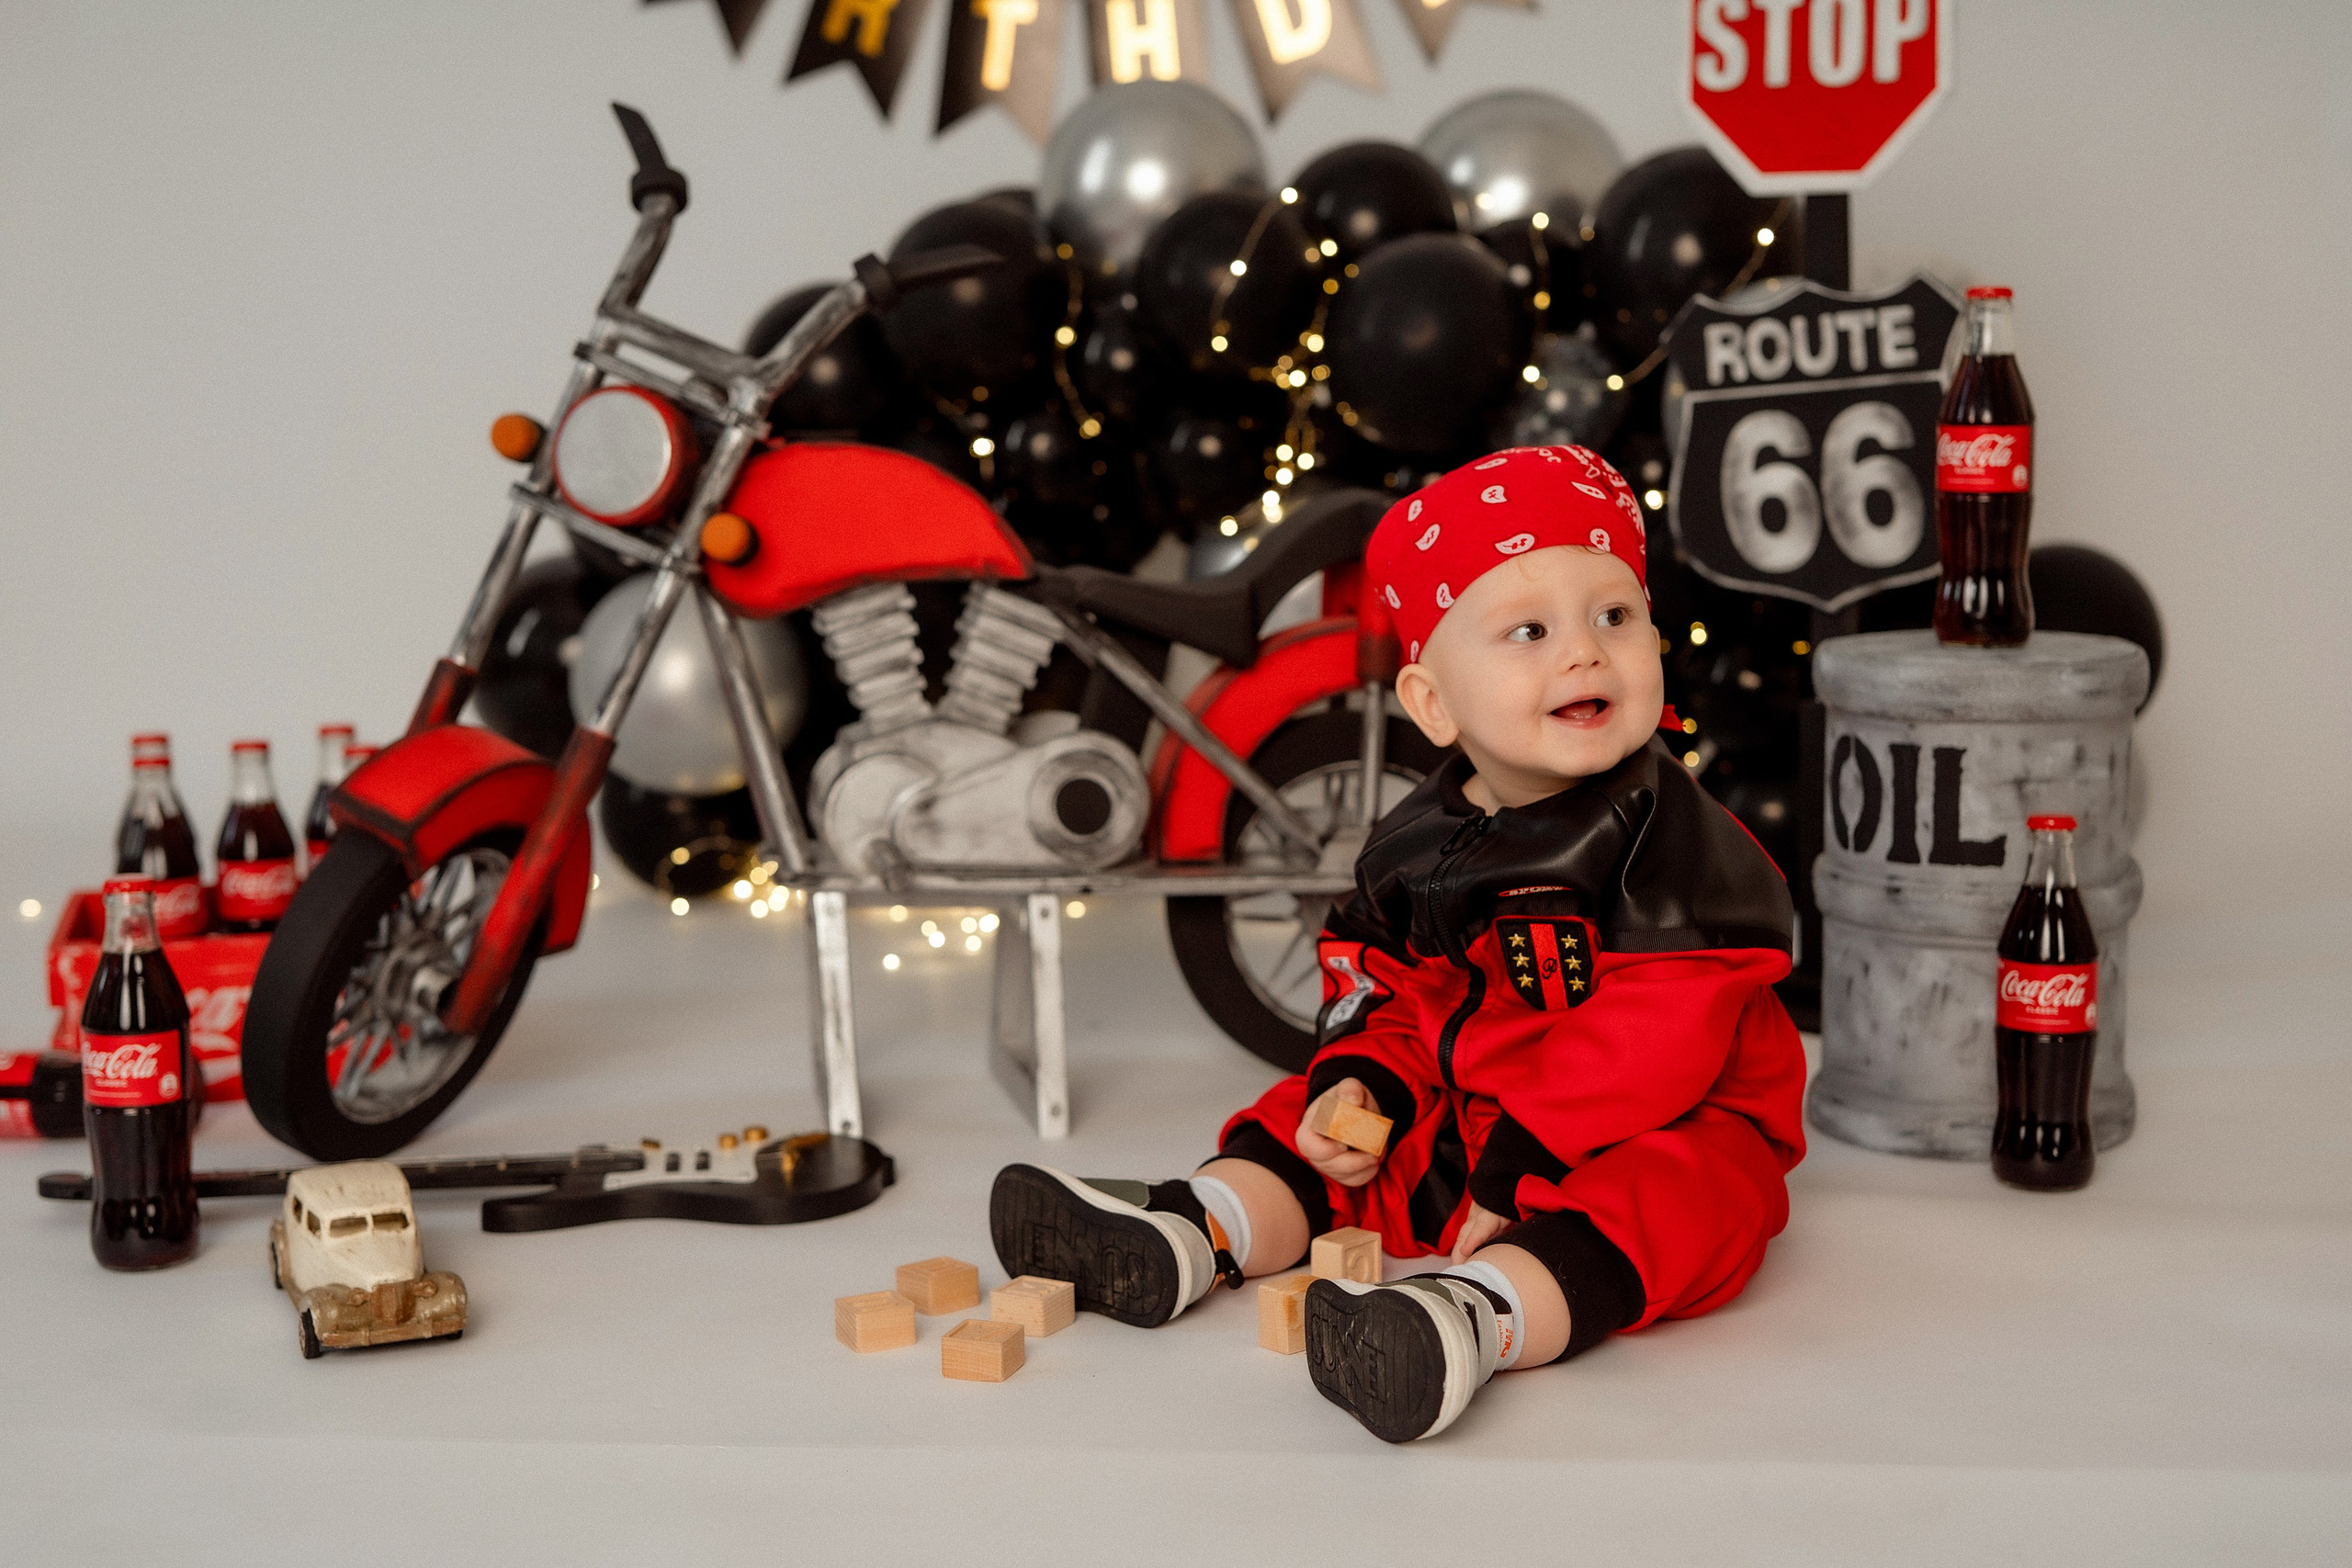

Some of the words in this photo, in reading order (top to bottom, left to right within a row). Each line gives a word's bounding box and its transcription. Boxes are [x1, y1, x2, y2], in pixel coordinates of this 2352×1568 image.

[1694, 0, 1929, 91] STOP
[1702, 304, 1919, 387] ROUTE
[1720, 400, 1927, 573] 66
[1831, 735, 2007, 867] OIL
[2001, 970, 2089, 1007] Coca-Cola
